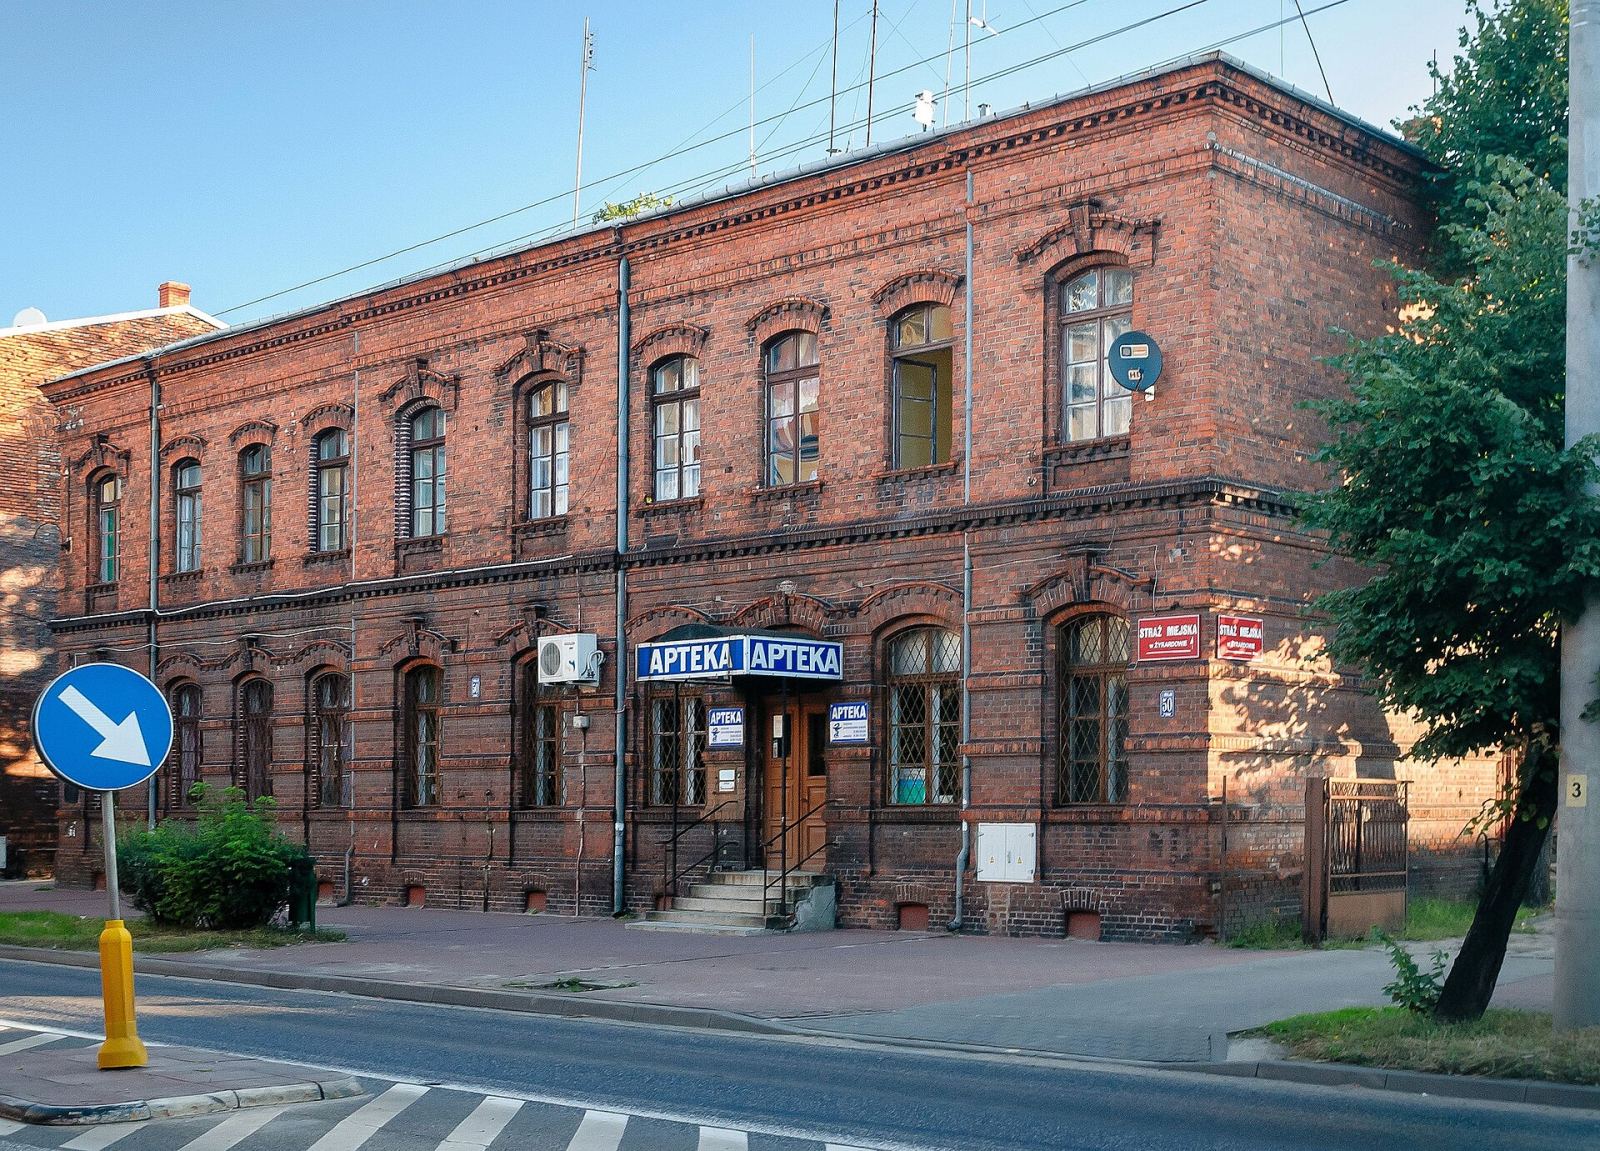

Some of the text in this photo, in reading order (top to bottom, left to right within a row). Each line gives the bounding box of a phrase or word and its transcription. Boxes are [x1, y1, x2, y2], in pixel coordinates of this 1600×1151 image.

[1140, 624, 1197, 638] STRAŻ MIEJSKA
[649, 642, 733, 674] APTEKA
[751, 642, 840, 673] APTEKA
[1162, 697, 1173, 712] 50
[710, 711, 742, 725] APTEKA
[831, 705, 867, 720] APTEKA
[1572, 782, 1581, 797] 3
